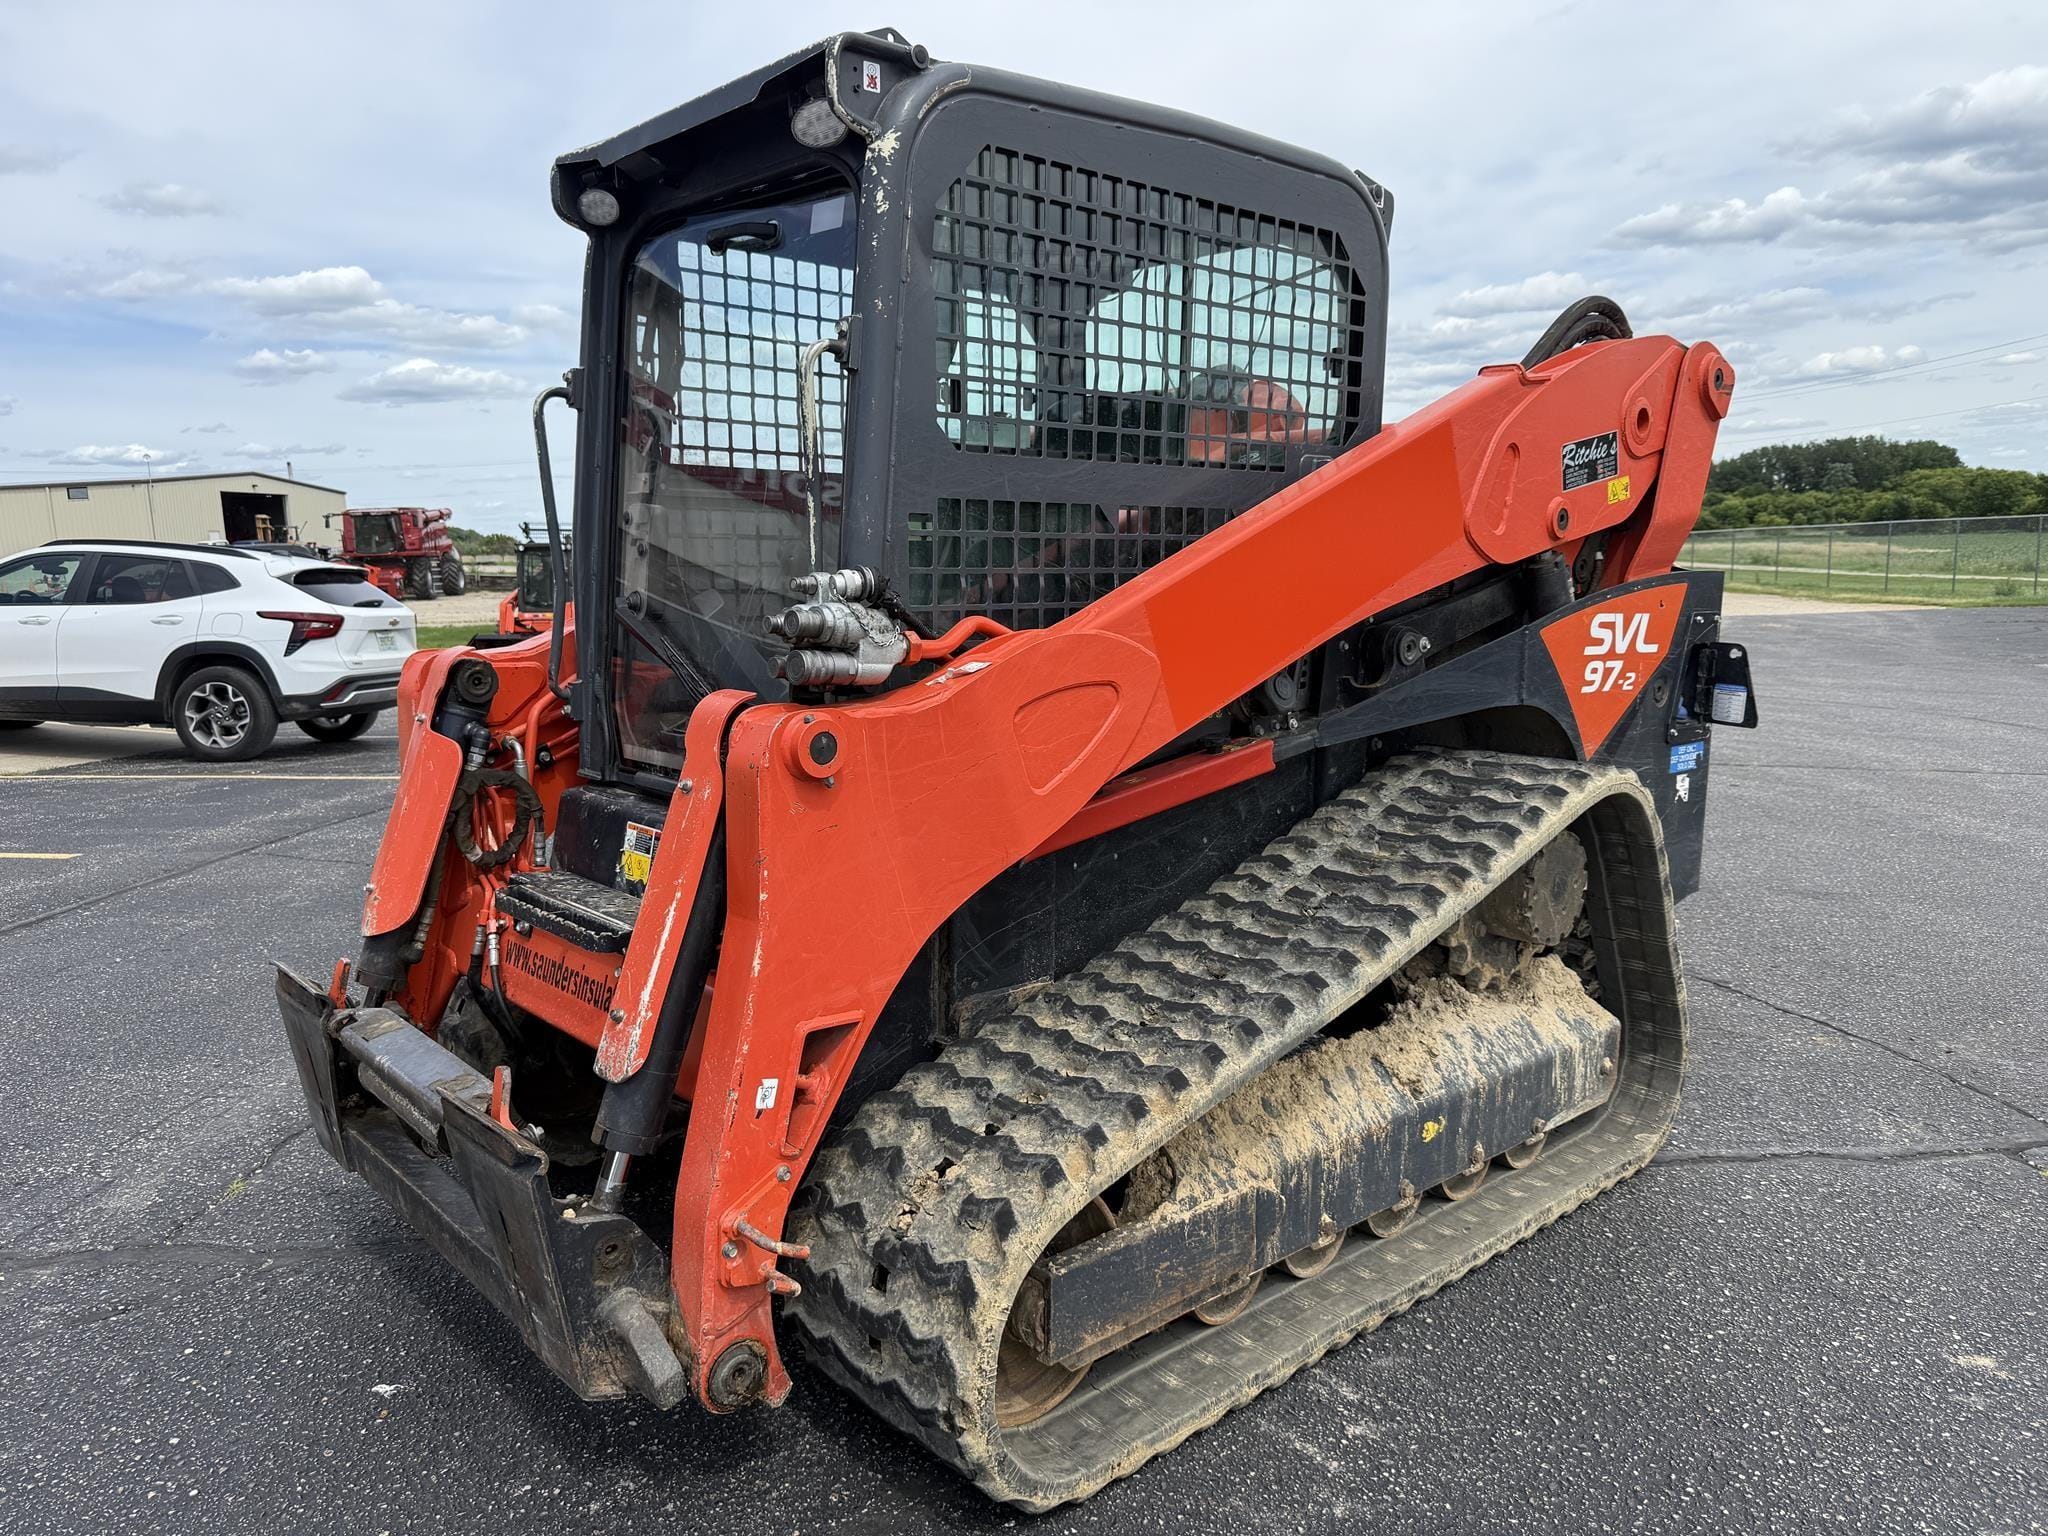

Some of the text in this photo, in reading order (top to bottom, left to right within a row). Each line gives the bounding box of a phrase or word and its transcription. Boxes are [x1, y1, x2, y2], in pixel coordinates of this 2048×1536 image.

[1562, 434, 1617, 469] Ritchie's
[1584, 613, 1659, 655] SVL
[1581, 660, 1636, 693] 97-2
